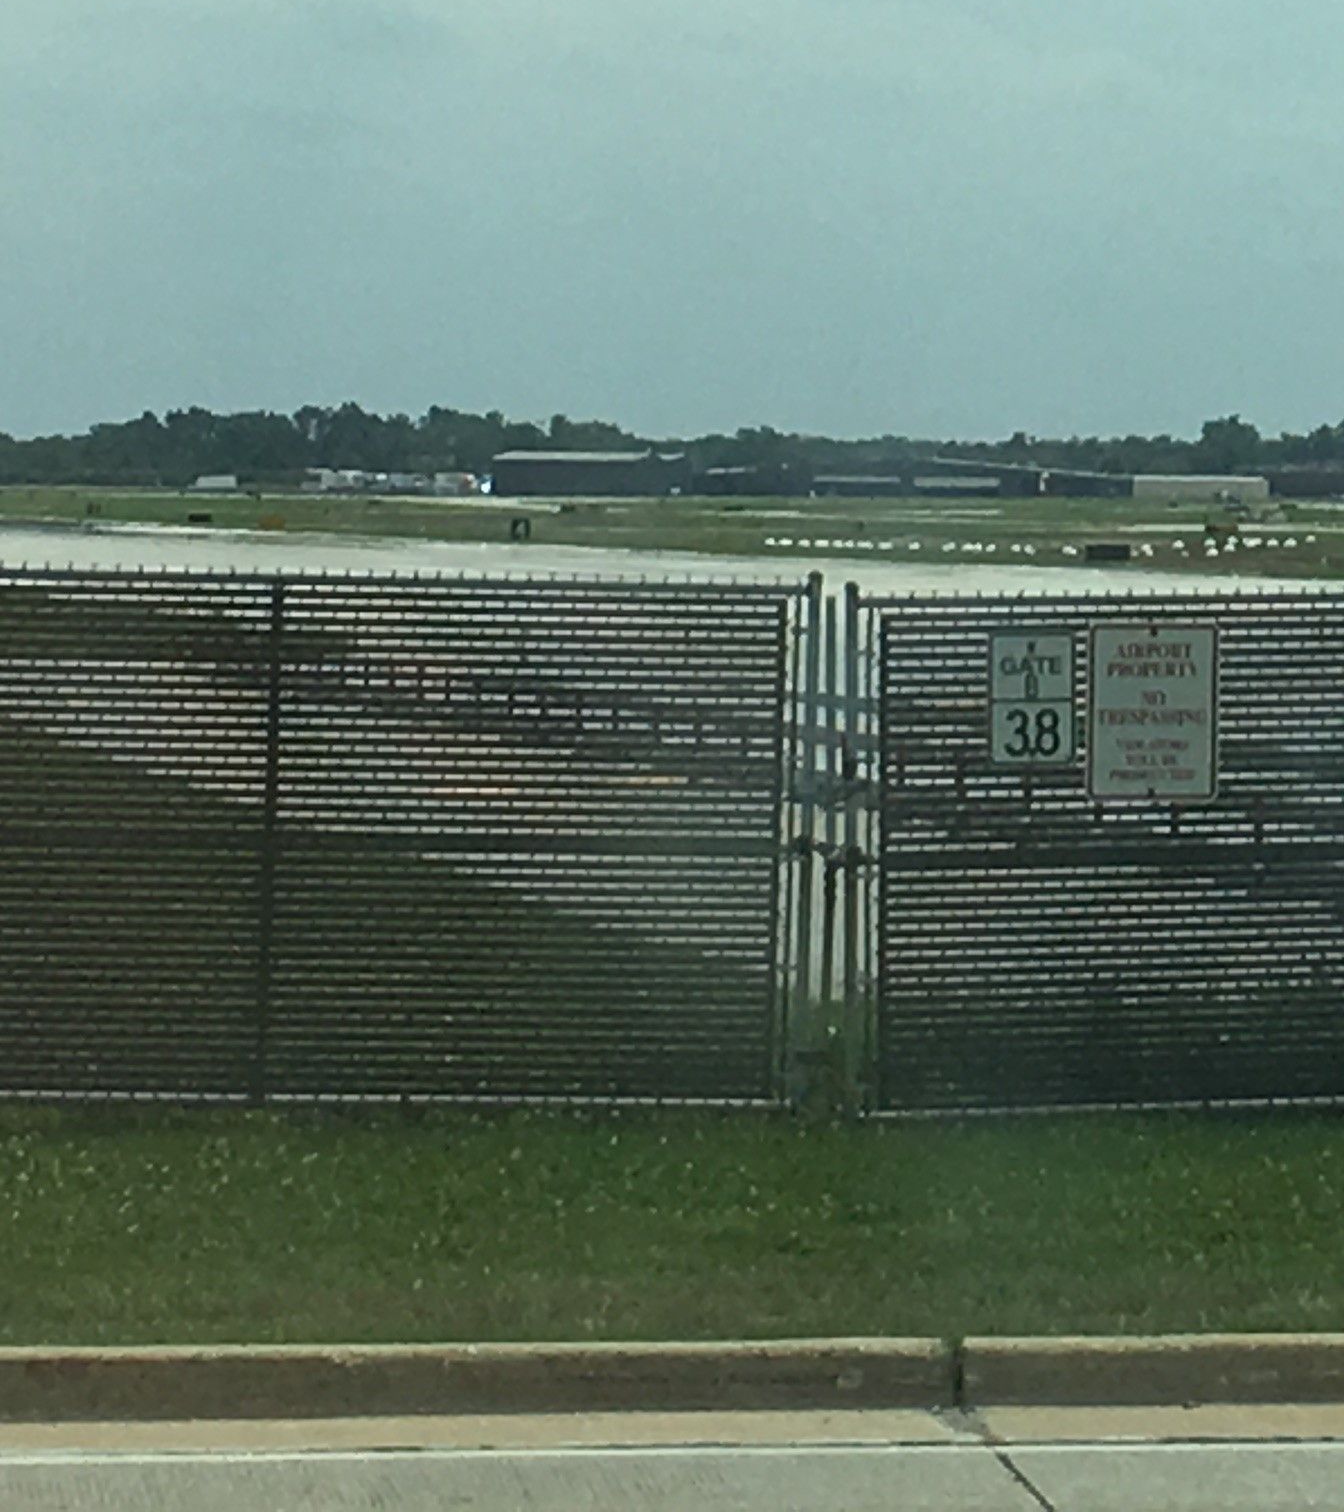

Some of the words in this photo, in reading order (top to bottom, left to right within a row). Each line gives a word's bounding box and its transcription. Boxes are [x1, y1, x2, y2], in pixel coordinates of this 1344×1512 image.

[1115, 643, 1192, 658] AIRPORT
[1000, 655, 1062, 676] GATE
[1107, 661, 1197, 678] PROPERTY
[1003, 708, 1061, 757] 38
